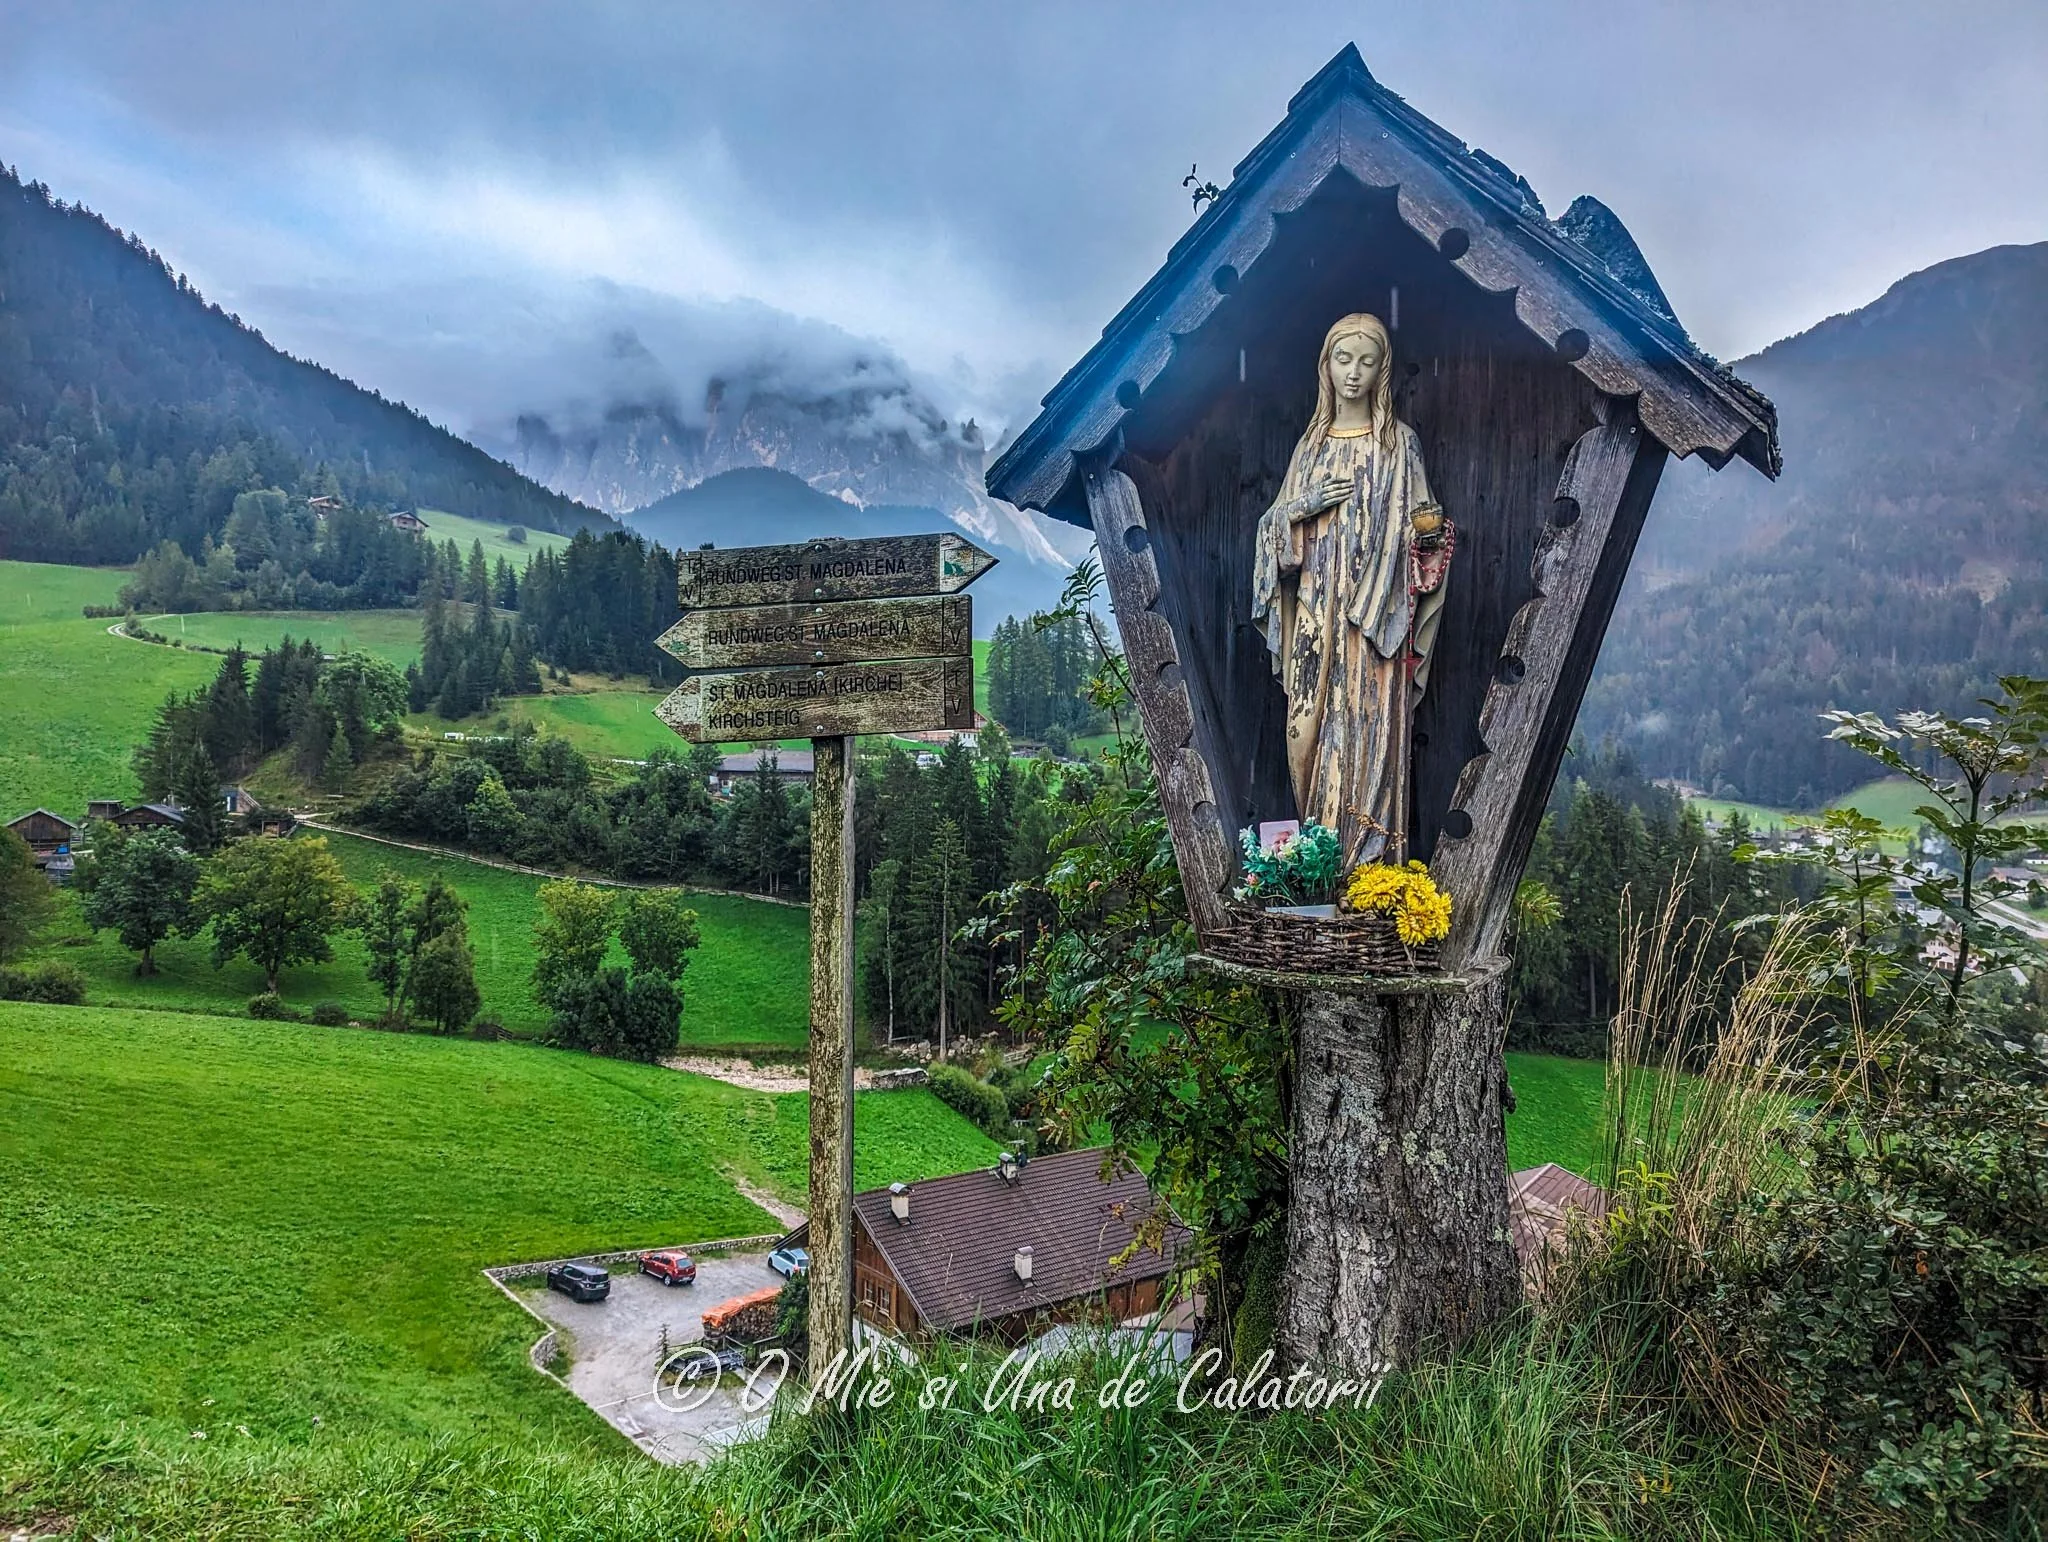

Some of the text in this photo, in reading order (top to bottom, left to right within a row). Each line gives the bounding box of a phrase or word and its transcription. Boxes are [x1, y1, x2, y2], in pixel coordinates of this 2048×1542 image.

[705, 566, 781, 586] RUNDWEG
[810, 558, 907, 580] MAGDALENA
[708, 625, 784, 646] RUNDWEG
[814, 619, 911, 640] MAGDALENA
[950, 628, 961, 646] V
[951, 669, 962, 687] T
[734, 679, 828, 701] MAGDALENA
[951, 697, 962, 715] V
[709, 708, 800, 730] KIRCHSTEIG
